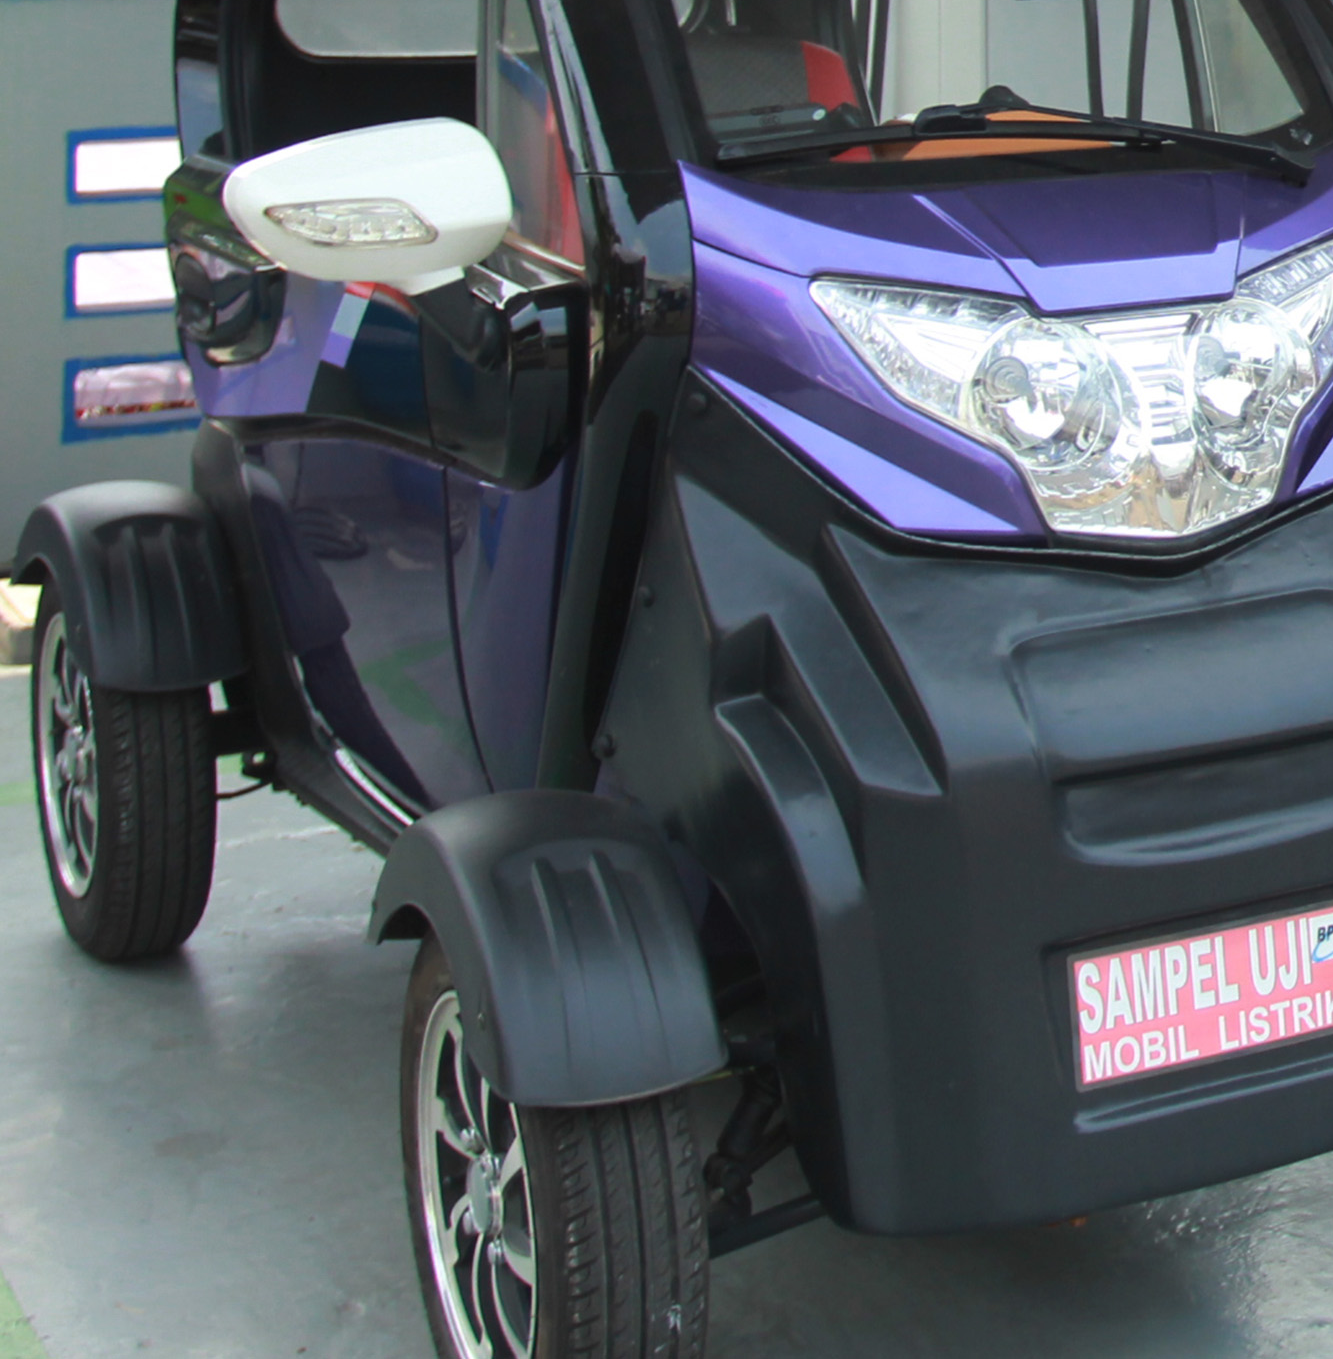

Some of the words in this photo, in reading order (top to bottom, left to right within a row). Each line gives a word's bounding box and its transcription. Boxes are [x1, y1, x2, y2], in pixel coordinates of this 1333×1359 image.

[1077, 935, 1240, 1035] SAMPEL
[1248, 917, 1312, 996] UJI
[1083, 1025, 1199, 1082] MOBIL
